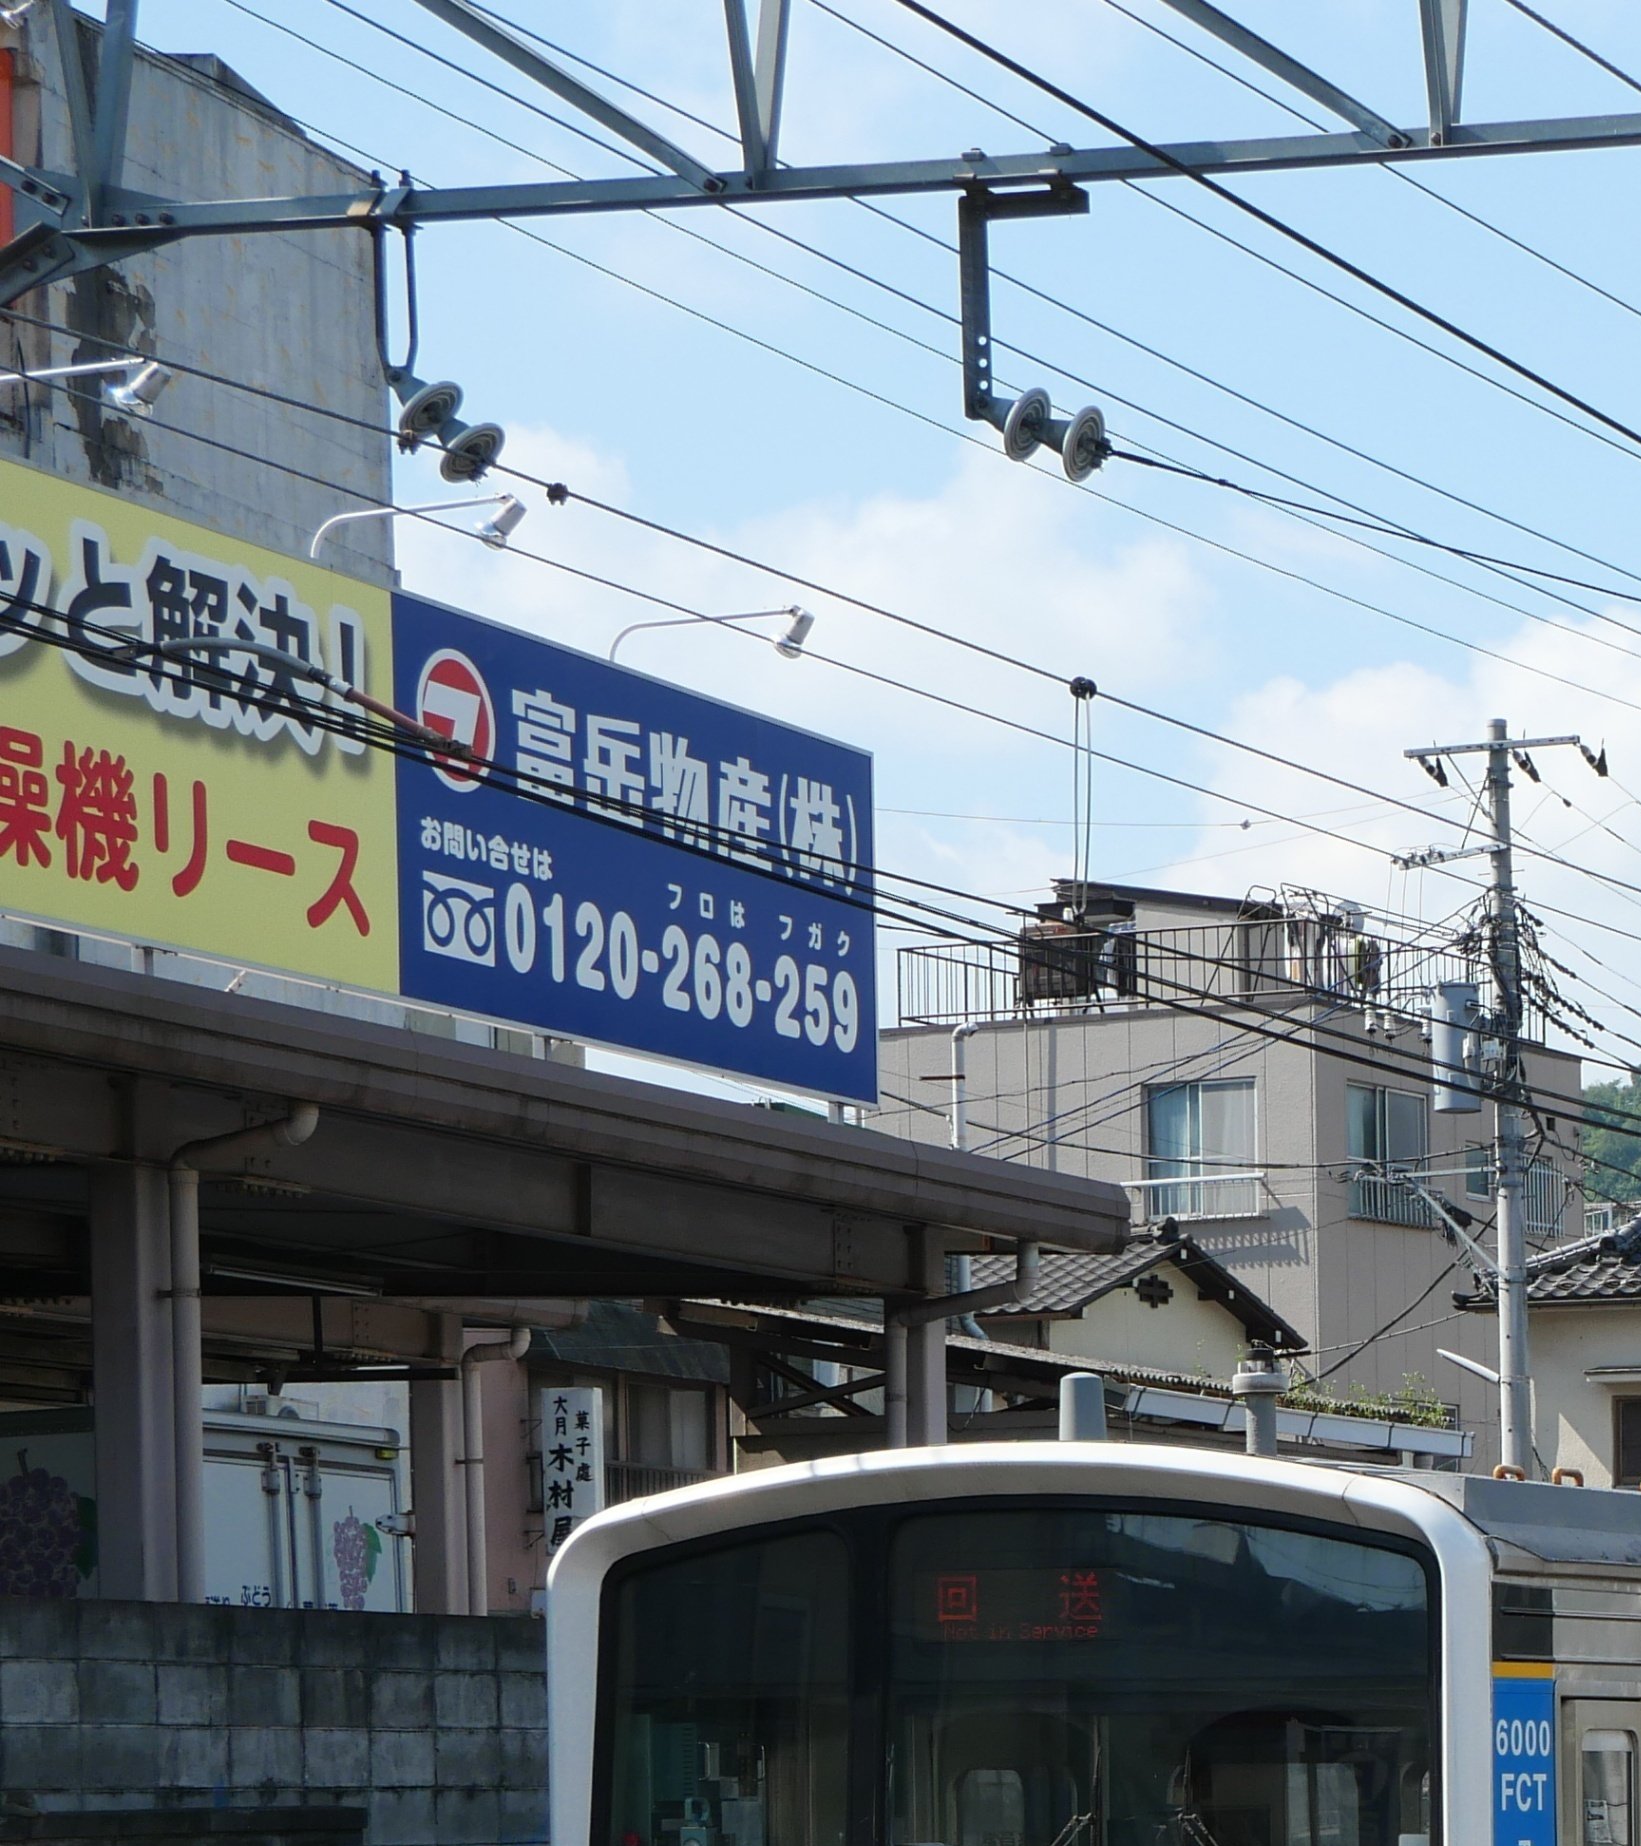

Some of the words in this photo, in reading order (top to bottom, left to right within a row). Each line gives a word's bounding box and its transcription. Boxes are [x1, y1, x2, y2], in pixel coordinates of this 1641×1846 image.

[420, 816, 553, 882] お問い合せは
[668, 883, 745, 929] フロは
[778, 914, 850, 956] フガク
[504, 882, 859, 1053] 0120-268-259
[553, 1395, 568, 1436] 大月
[944, 1623, 977, 1641] Not
[991, 1623, 1011, 1640] in
[1019, 1621, 1098, 1640] Service
[1495, 1718, 1551, 1758] 6000
[1501, 1772, 1547, 1813] FCT
